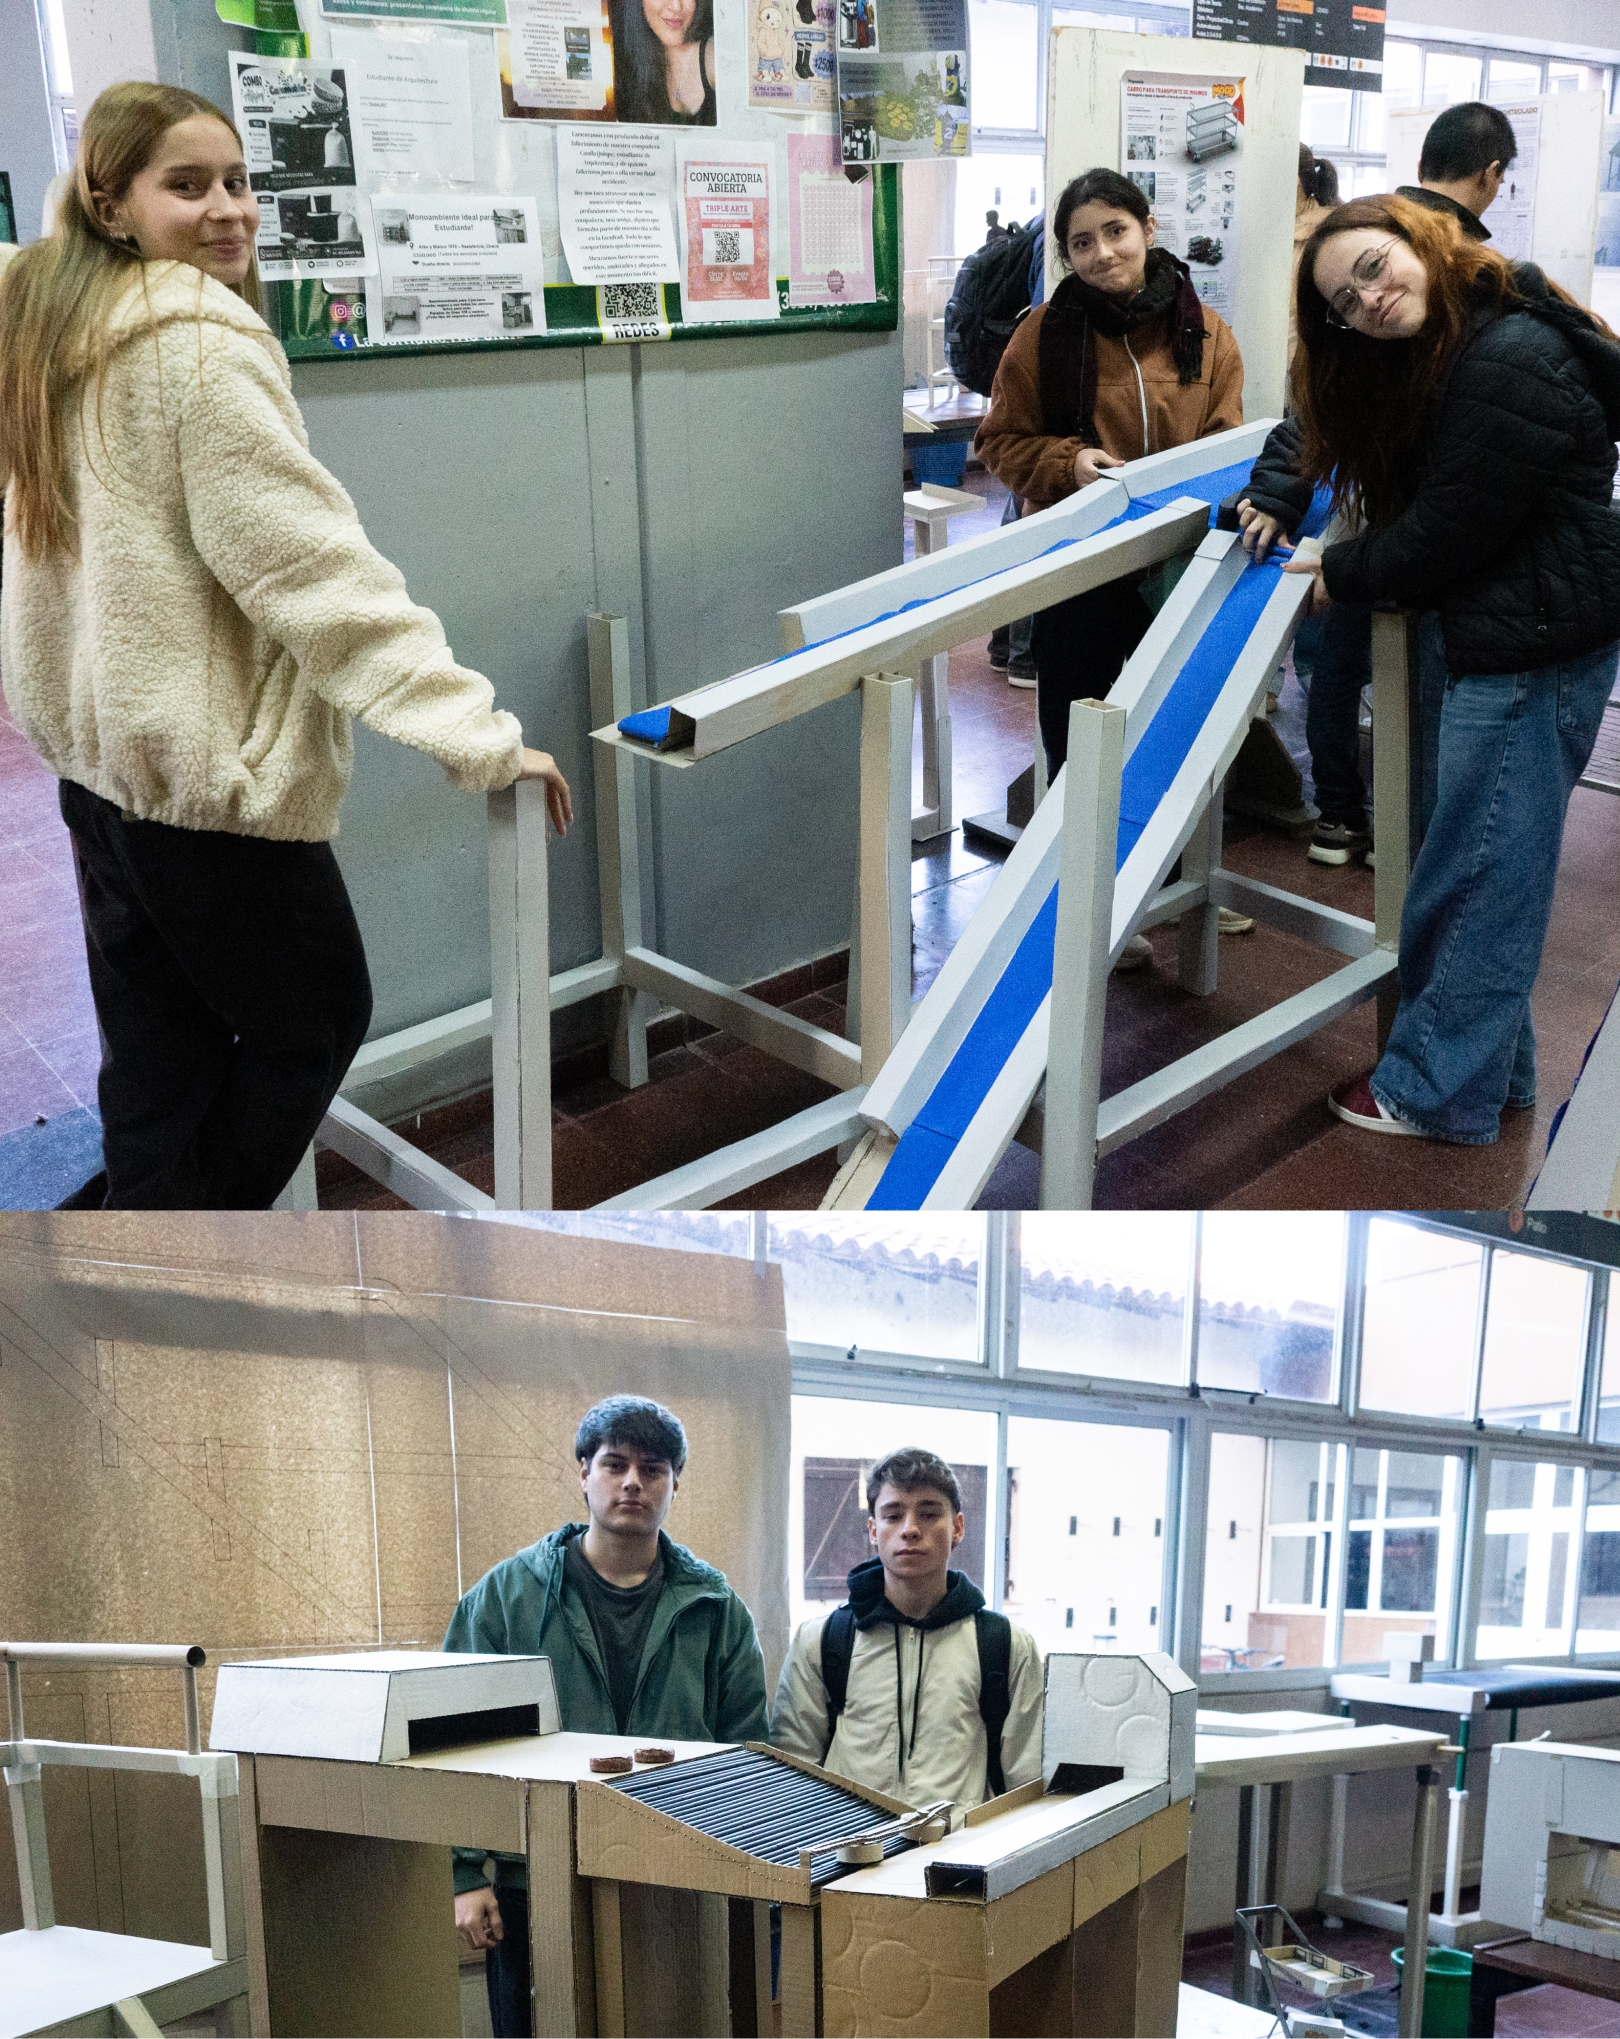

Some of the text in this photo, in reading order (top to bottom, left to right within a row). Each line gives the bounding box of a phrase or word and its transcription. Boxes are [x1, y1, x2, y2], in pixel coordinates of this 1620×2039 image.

[366, 74, 395, 82] Estudiante
[404, 76, 438, 85] Arquitectura
[690, 172, 763, 183] CONVOCATORIA
[707, 183, 747, 193] ABIERTA
[612, 322, 659, 338] REDES
[1527, 1216, 1548, 1234] Patio
